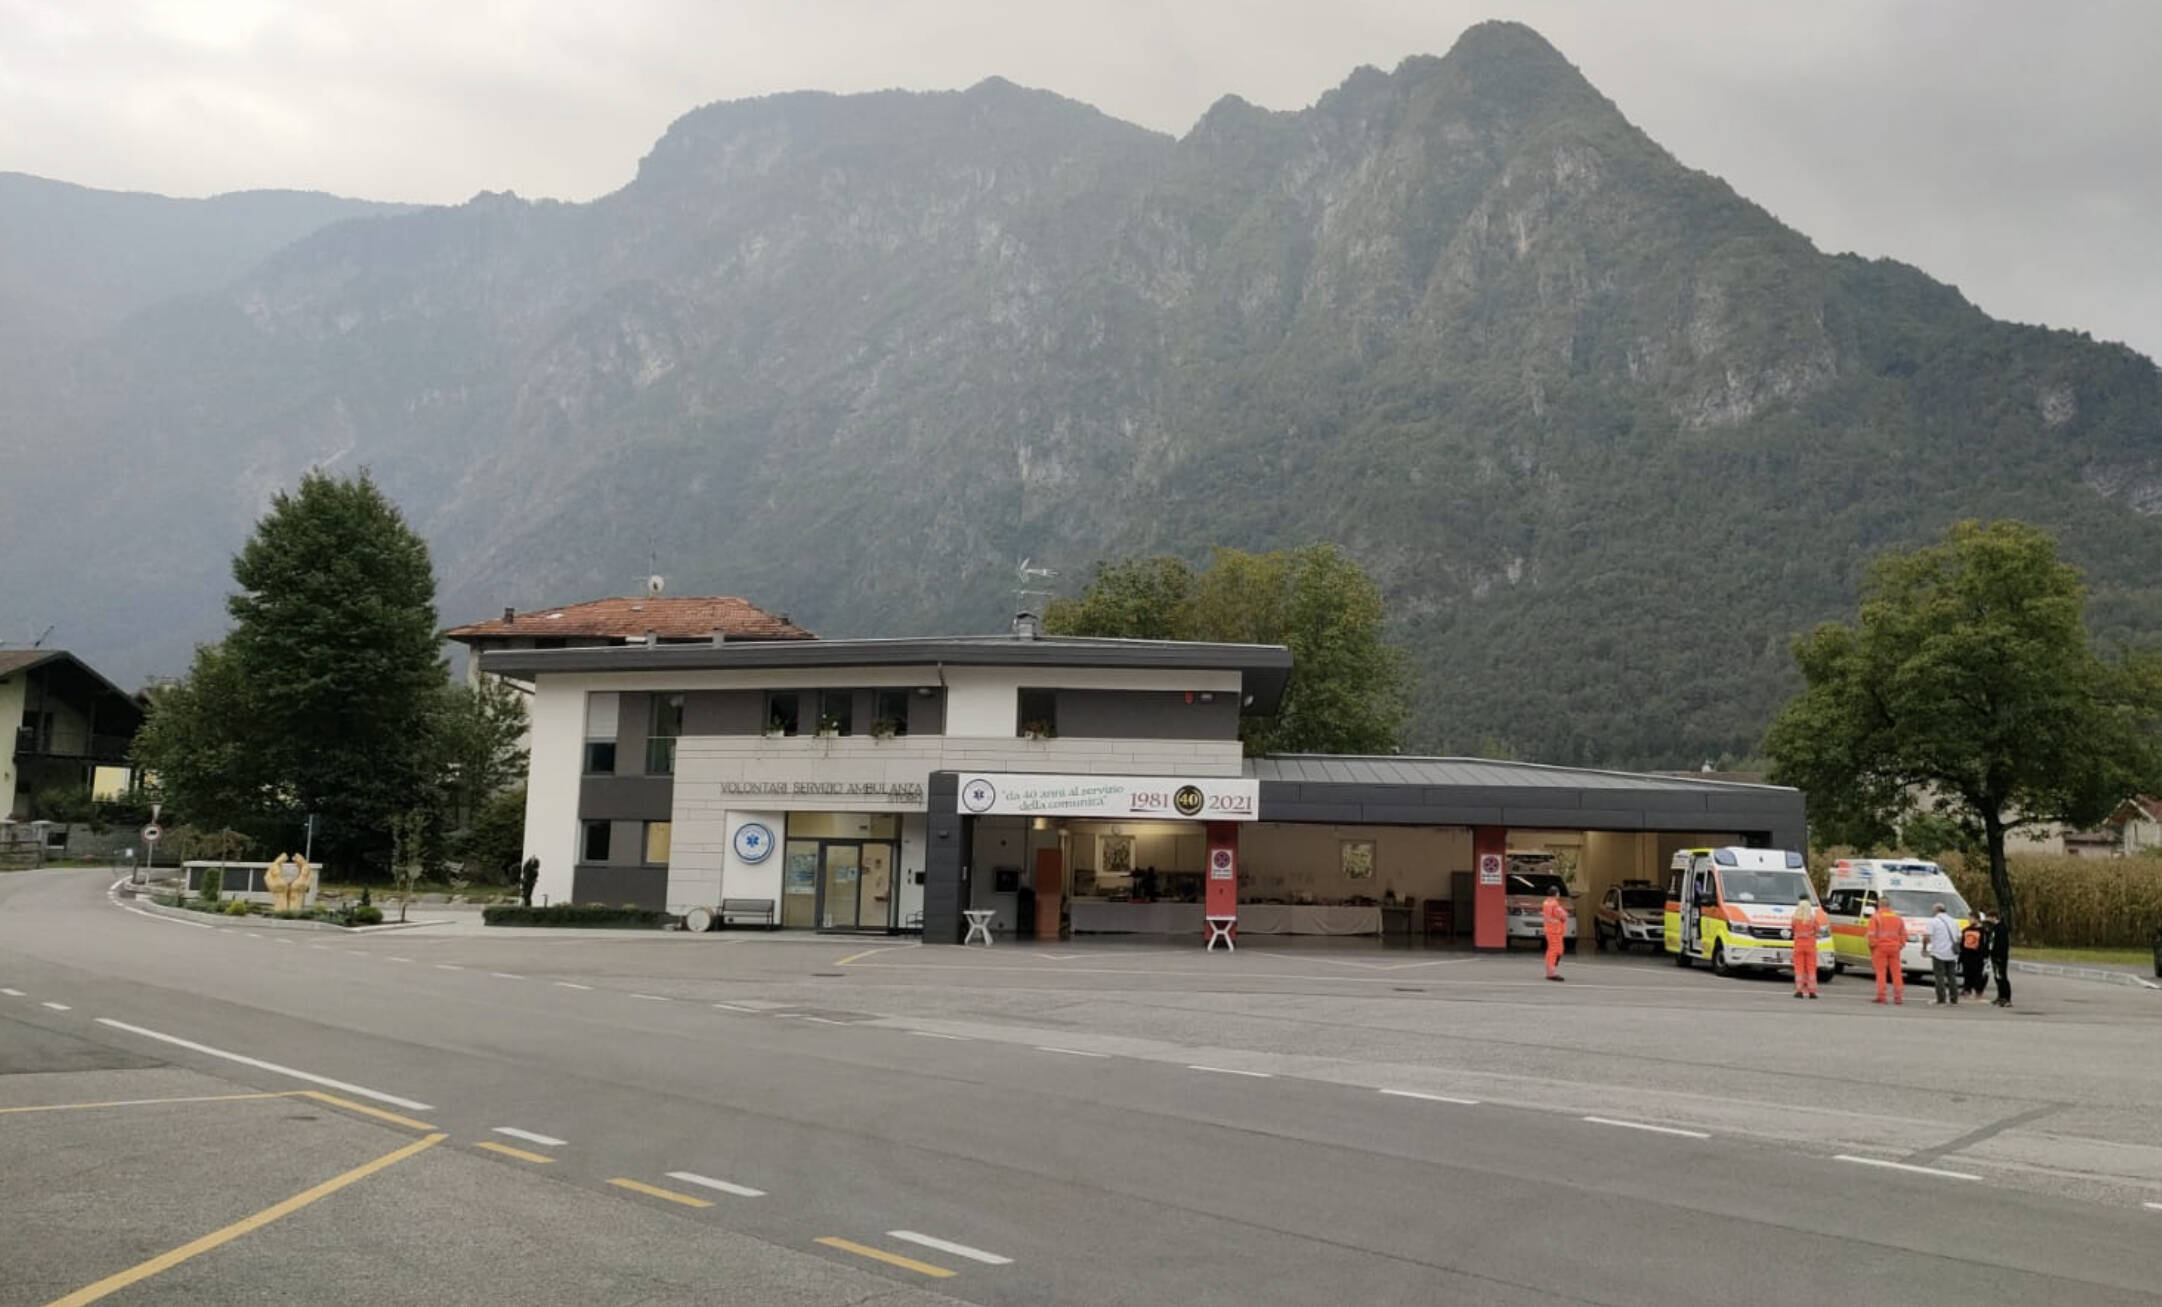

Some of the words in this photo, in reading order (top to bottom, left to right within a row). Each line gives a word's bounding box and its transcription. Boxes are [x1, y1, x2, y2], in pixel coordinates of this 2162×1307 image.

[720, 783, 787, 794] VOLONTARI
[793, 783, 842, 794] SERVIZIO
[847, 783, 923, 795] AMBULANZA
[1022, 789, 1037, 799] 40
[1040, 788, 1065, 798] anni
[1068, 786, 1079, 796] al
[1081, 785, 1124, 796] servizio
[1019, 799, 1046, 811] della
[1130, 793, 1168, 808] 1981
[1179, 794, 1199, 806] 40
[1209, 795, 1252, 809] 2021
